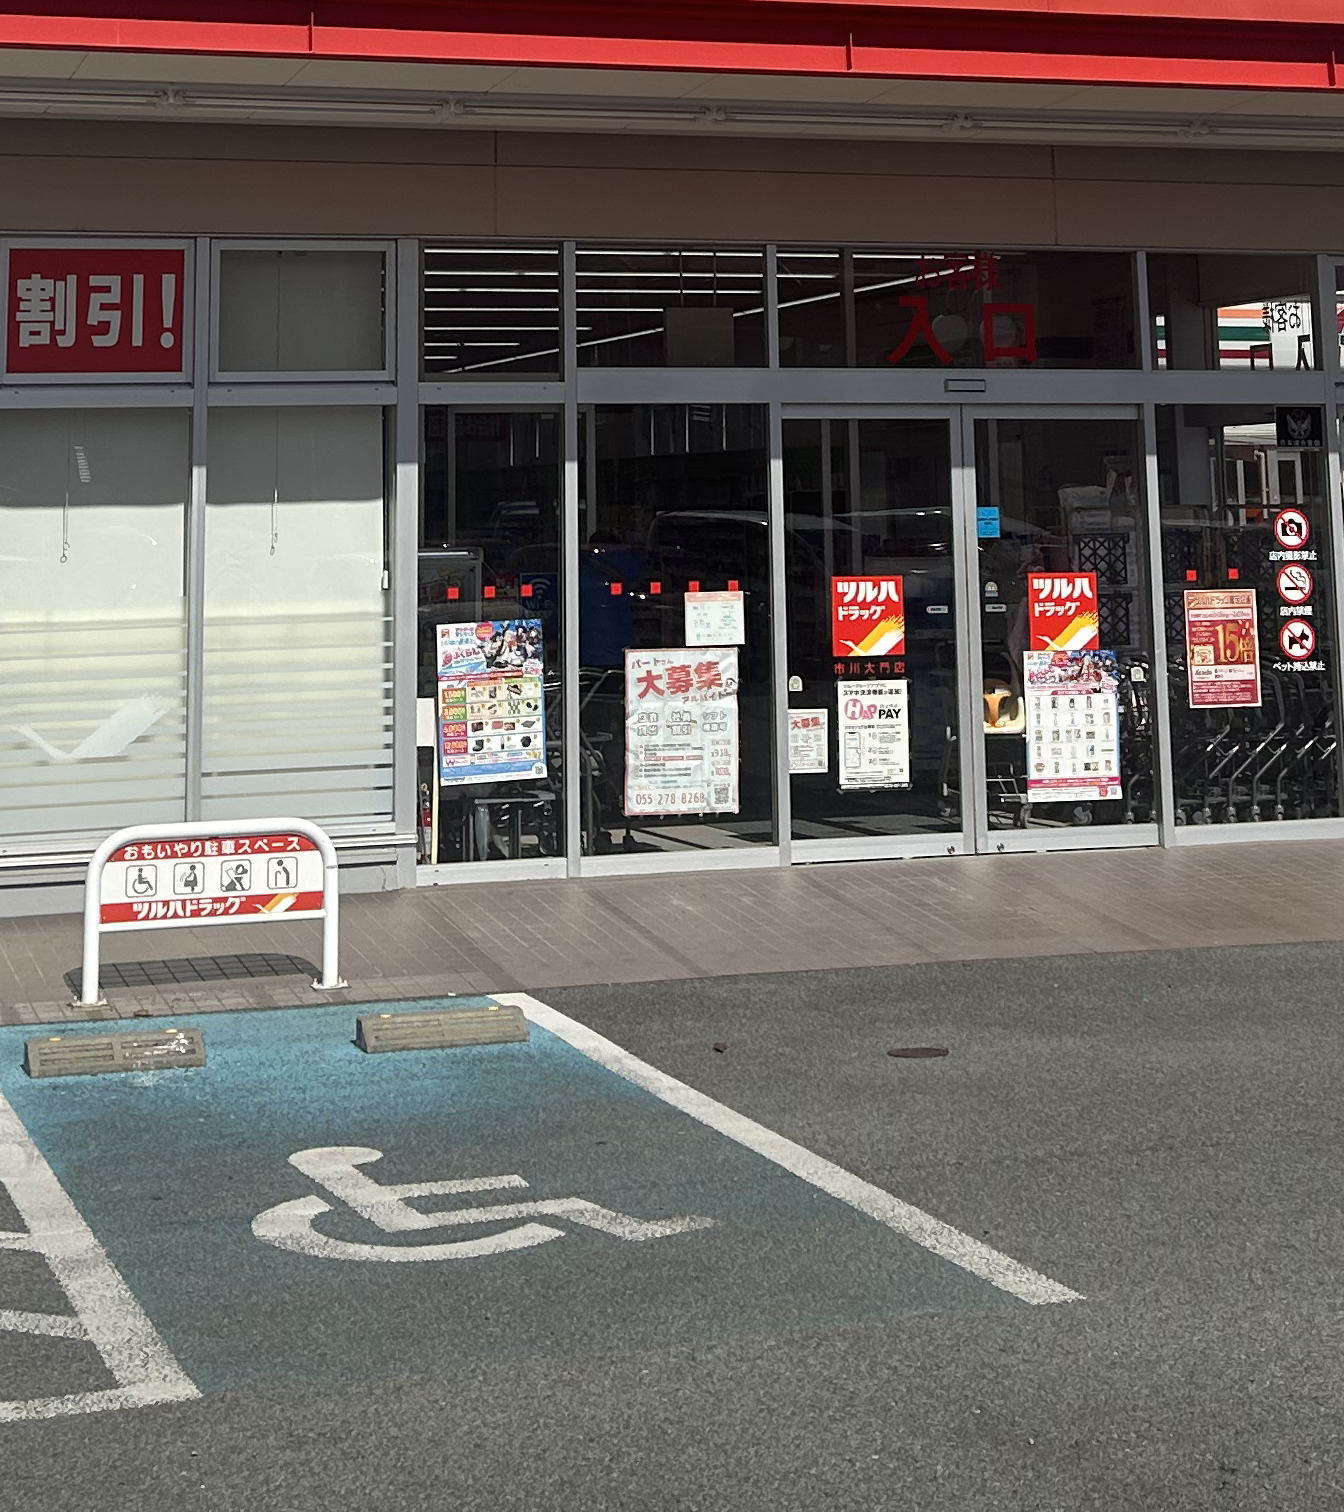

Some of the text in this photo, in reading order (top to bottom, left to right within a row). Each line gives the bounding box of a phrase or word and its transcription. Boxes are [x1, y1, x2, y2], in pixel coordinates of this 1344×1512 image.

[16, 274, 175, 349] 割引!
[888, 296, 1036, 365] 入口
[836, 581, 899, 603] ツルハ
[1032, 578, 1093, 599] ツルハ
[837, 605, 885, 621] ドラッグ
[1034, 601, 1081, 617] ドラッグ
[834, 661, 905, 674] 市川大門店
[636, 660, 724, 699] 大募集
[124, 837, 301, 860] おもいやり駐車スペース
[133, 896, 246, 919] ツルハドラッグ
